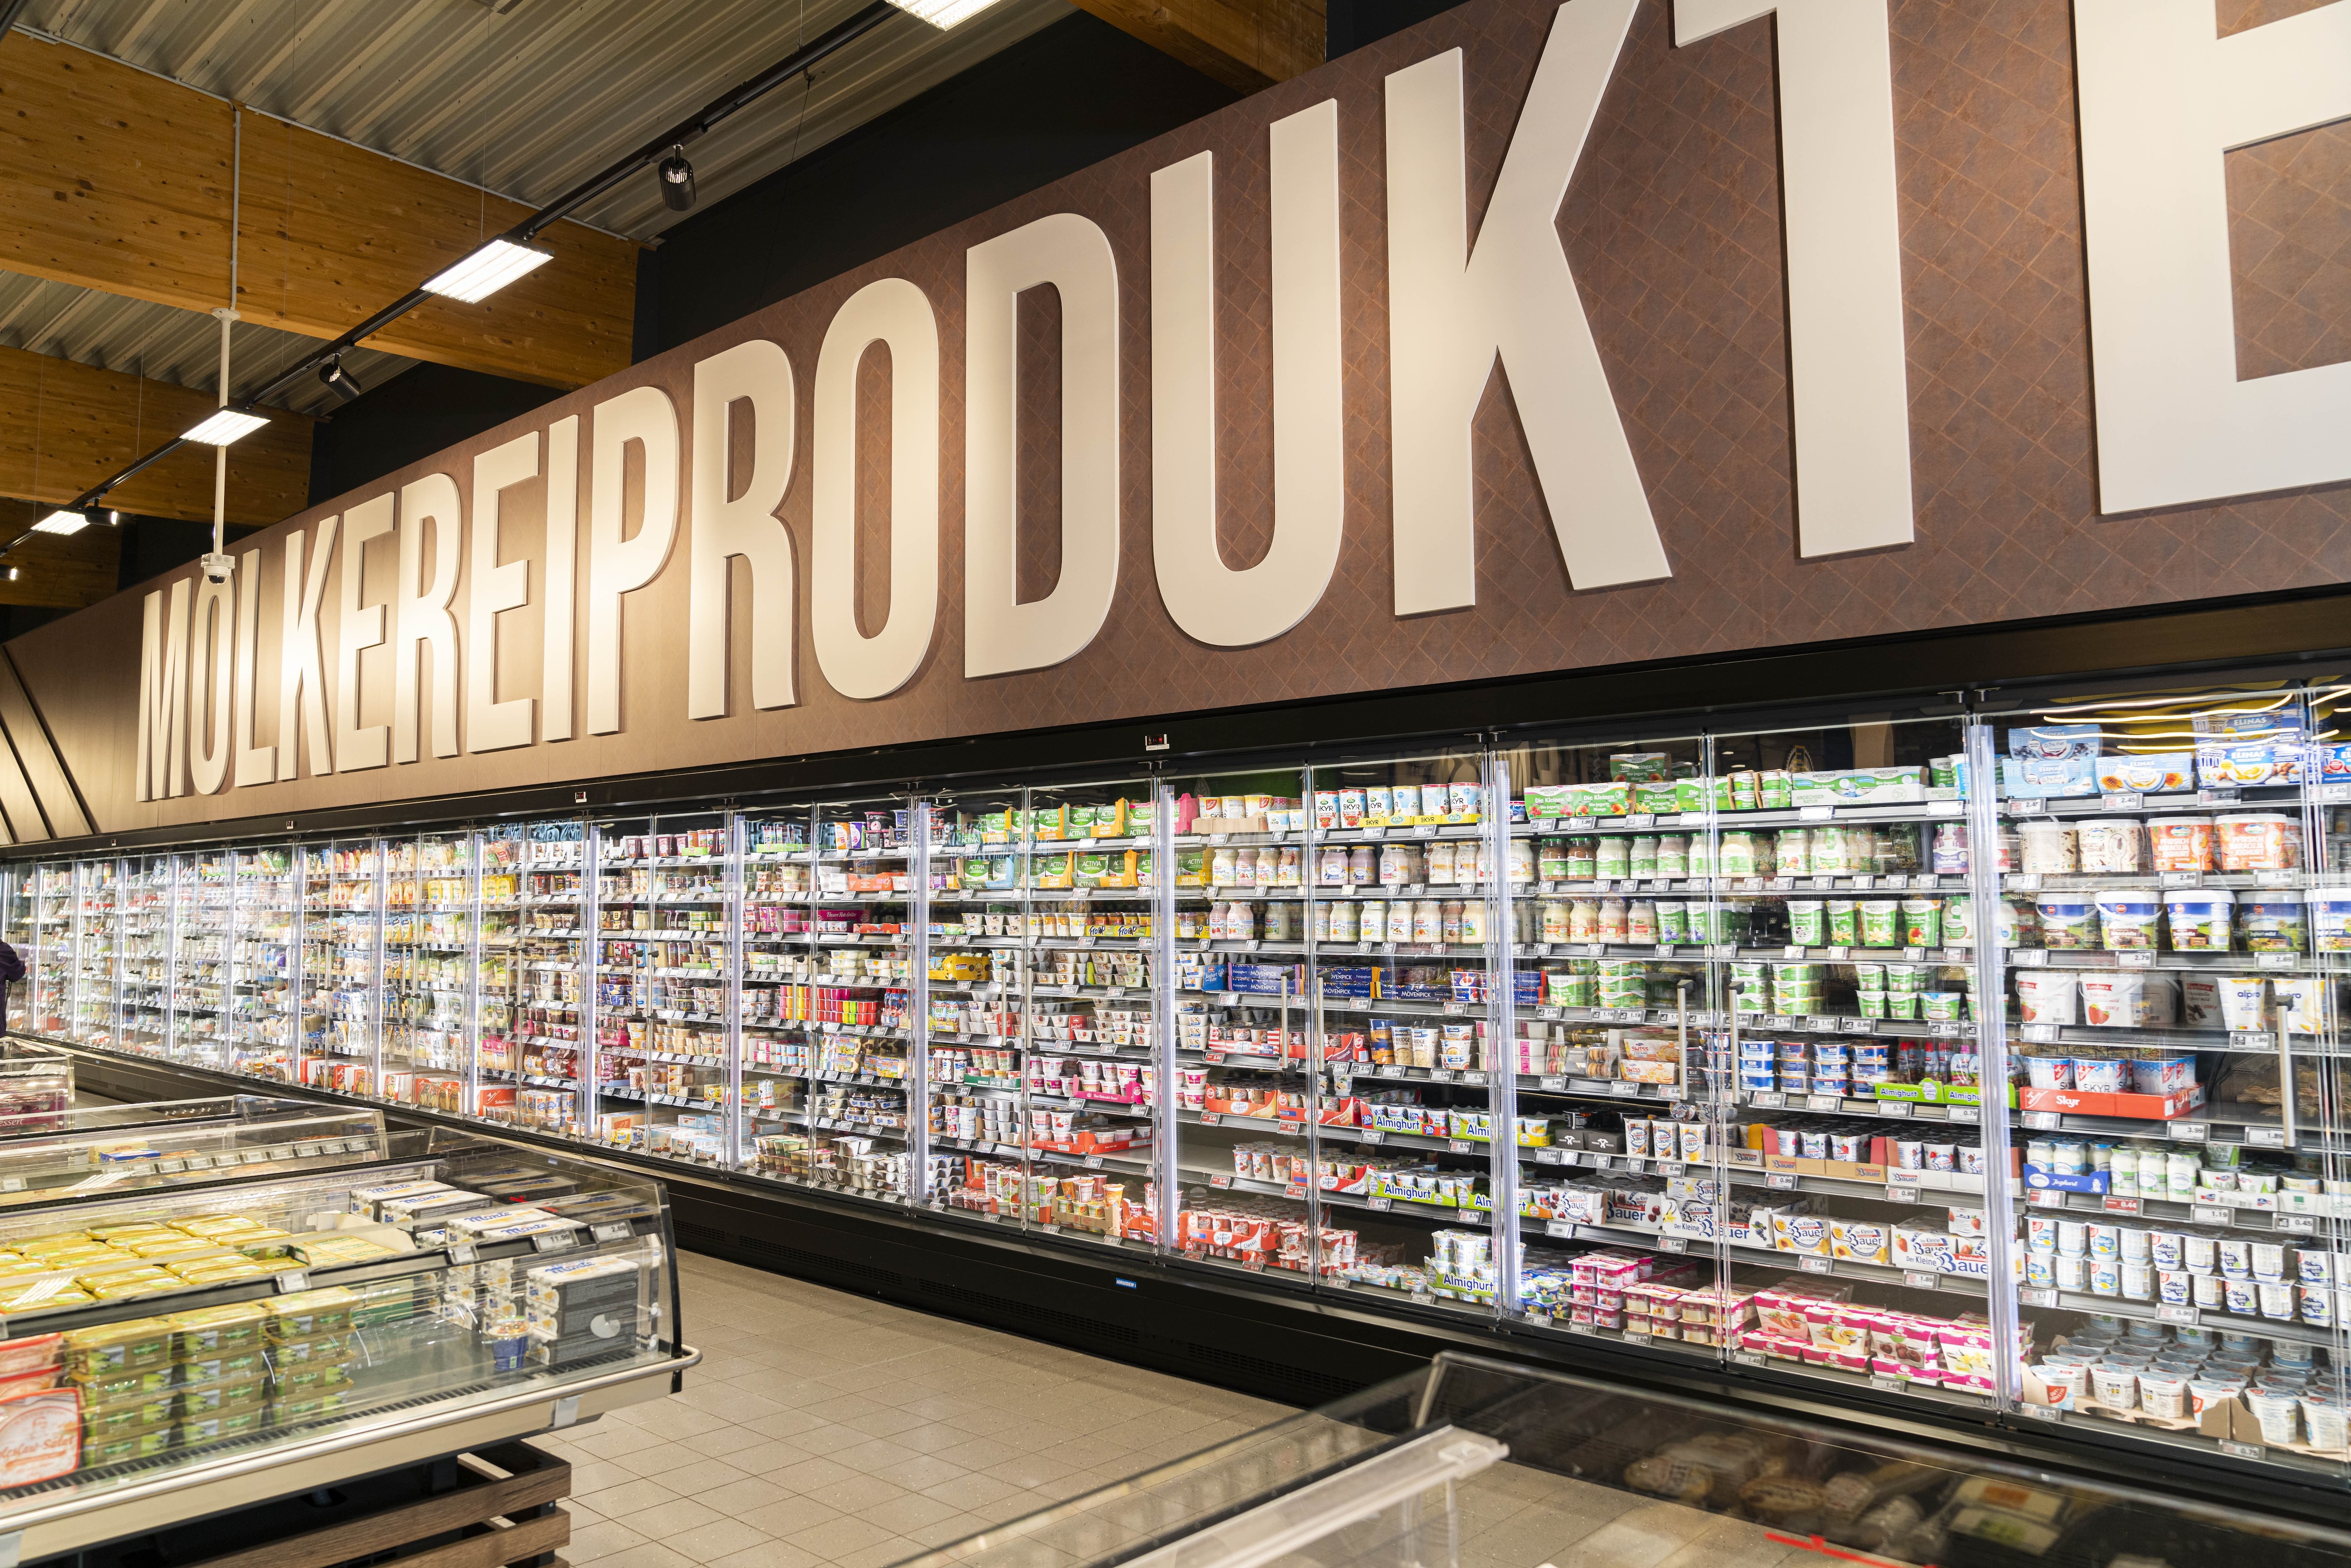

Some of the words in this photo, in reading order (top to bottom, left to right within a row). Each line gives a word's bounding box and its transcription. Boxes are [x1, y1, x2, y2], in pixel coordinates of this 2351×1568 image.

[2233, 717, 2267, 725] ELINAS
[1401, 989, 1431, 998] MÖVENPICK
[1880, 1087, 1917, 1098] Almighurt
[2084, 1083, 2111, 1093] SKYR
[2056, 1095, 2080, 1108] Skyr
[1376, 1115, 1420, 1130] Almighurt
[1349, 1182, 1365, 1192] Classic
[1384, 1185, 1431, 1199] Almighurt
[1243, 1239, 1257, 1249] Classic
[1915, 1258, 1937, 1267] Kleine
[1443, 1273, 1494, 1292] Almighurt
